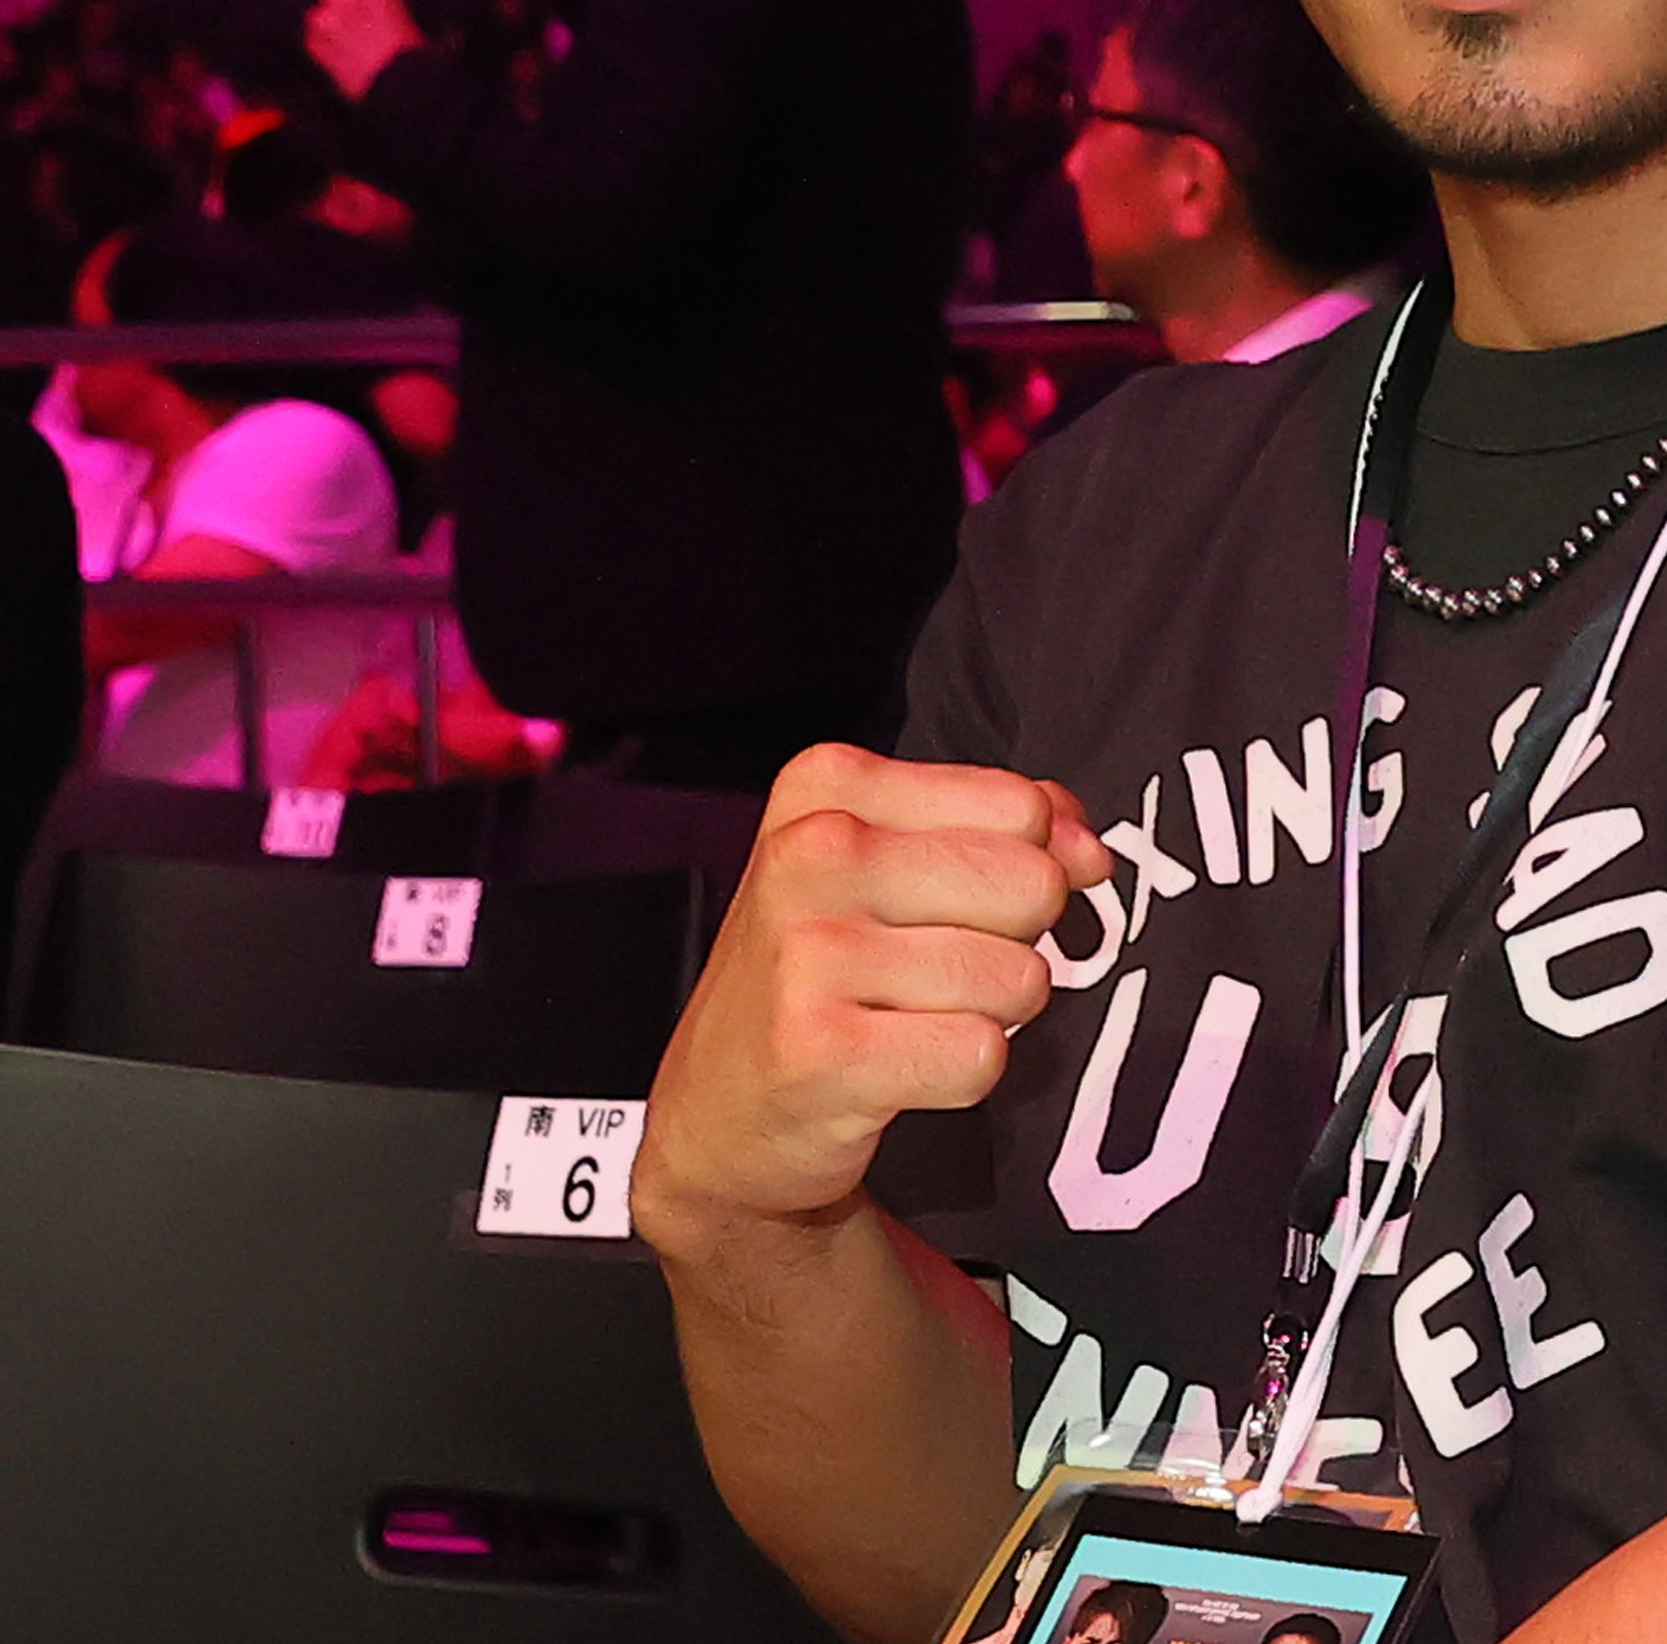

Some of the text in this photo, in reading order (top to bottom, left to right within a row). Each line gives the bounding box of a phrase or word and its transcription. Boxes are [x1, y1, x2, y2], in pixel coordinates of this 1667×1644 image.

[1004, 684, 1405, 1039] OXING
[579, 1108, 625, 1138] VIP
[562, 1156, 599, 1223] 6
